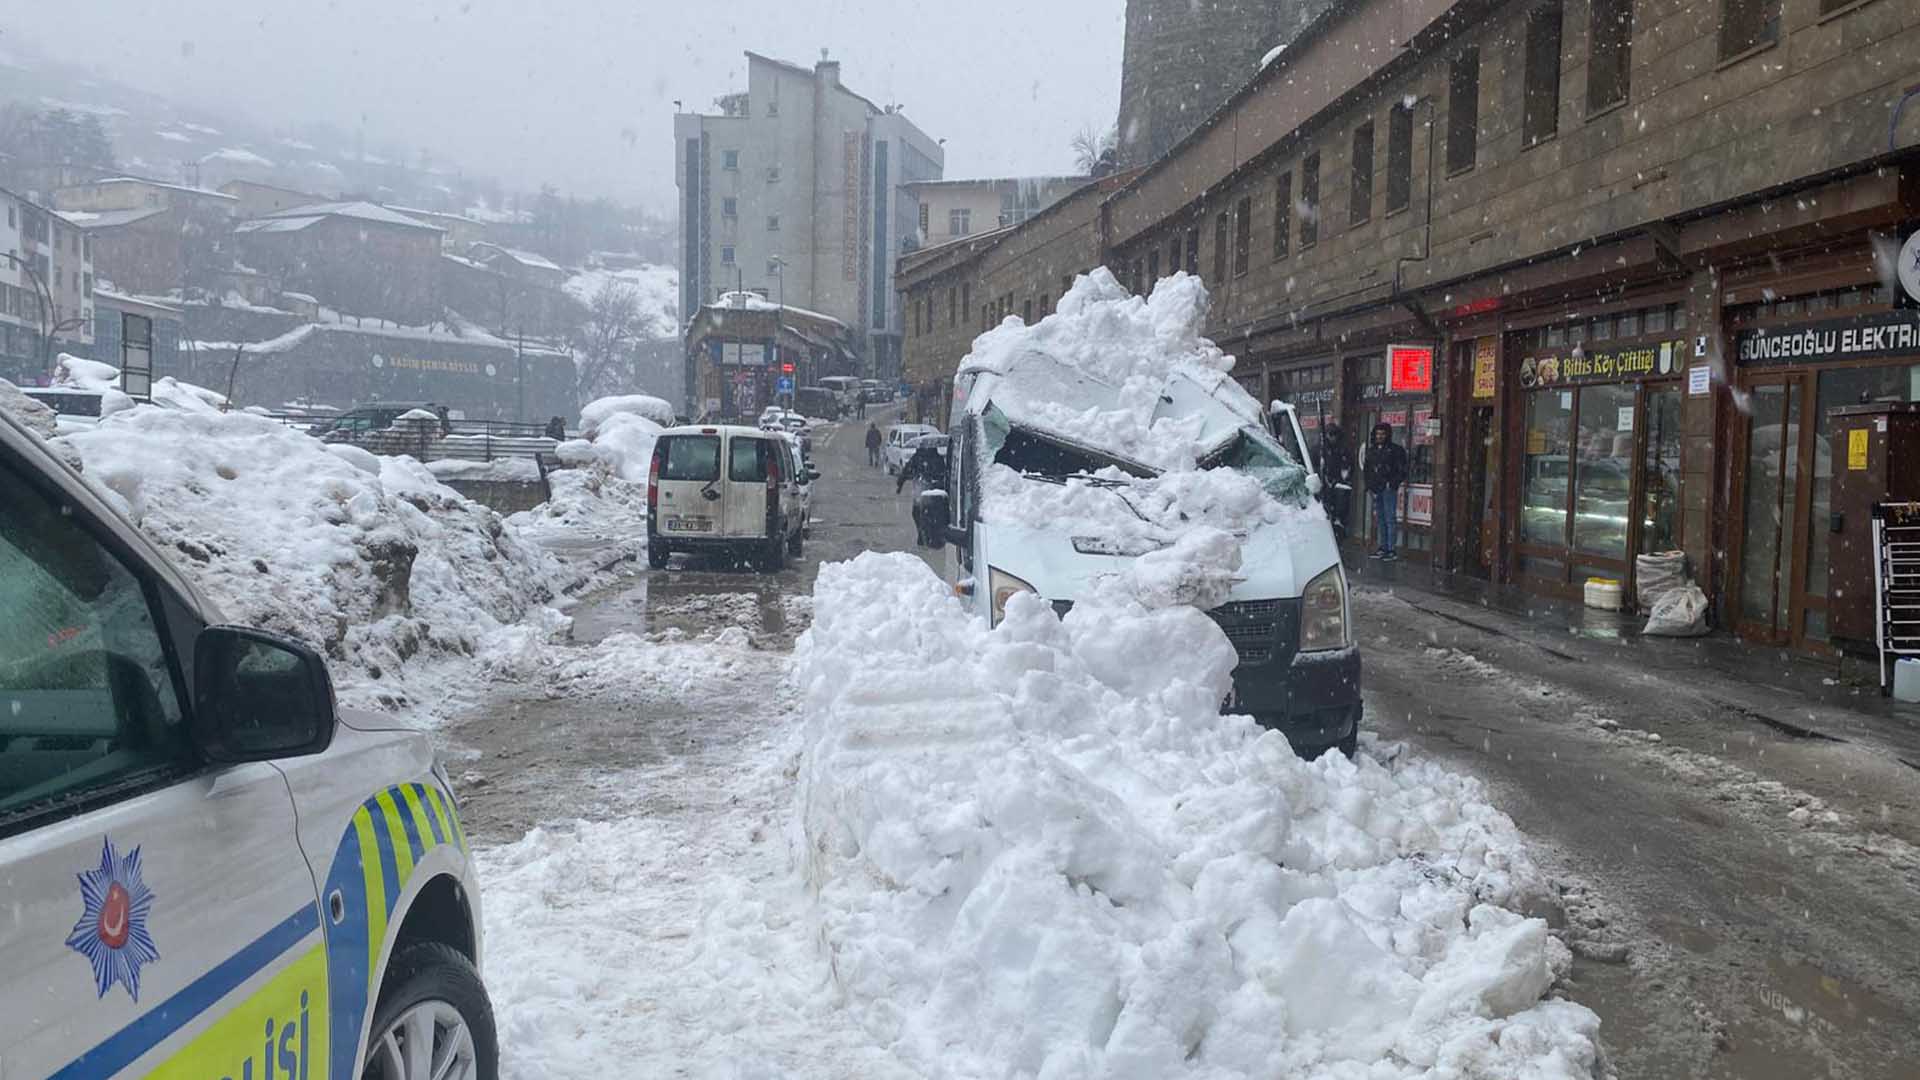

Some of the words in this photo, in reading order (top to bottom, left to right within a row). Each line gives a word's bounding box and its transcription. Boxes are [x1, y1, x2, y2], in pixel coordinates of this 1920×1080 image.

[1740, 328, 1836, 360] GÜNCEOĞLU
[1594, 354, 1616, 378] Köy
[1616, 349, 1655, 376] Çiftliği
